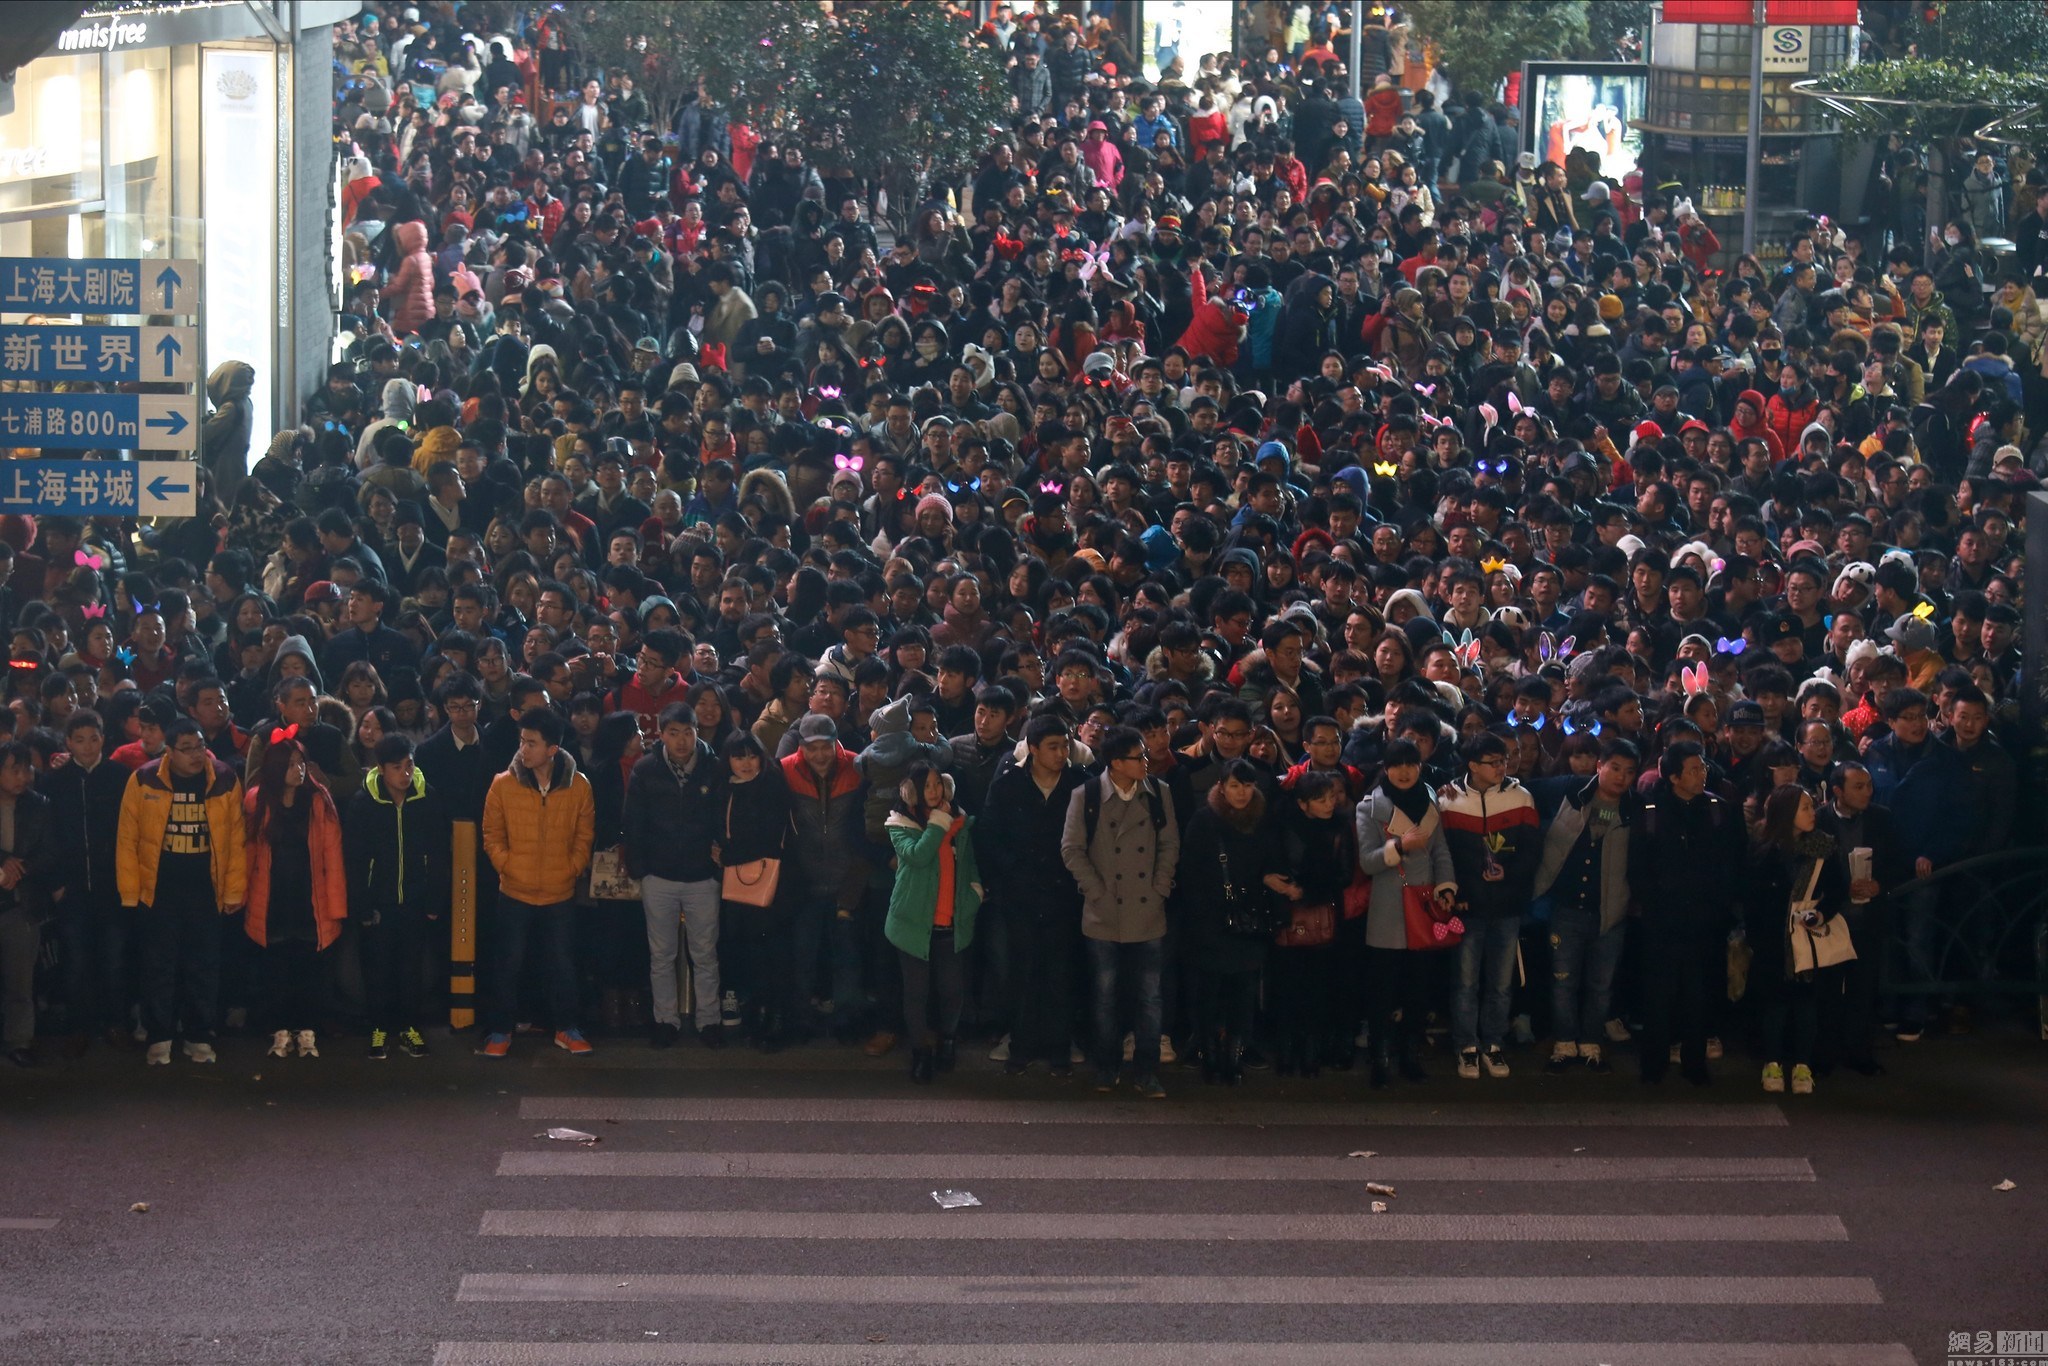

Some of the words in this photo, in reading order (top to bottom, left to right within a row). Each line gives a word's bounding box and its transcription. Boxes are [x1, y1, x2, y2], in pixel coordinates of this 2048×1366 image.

[58, 15, 147, 51] innisfree
[5, 266, 134, 305] 上海大剧院
[4, 333, 135, 371] 新世界
[3, 469, 134, 506] 上海书城
[170, 803, 207, 822] OCK
